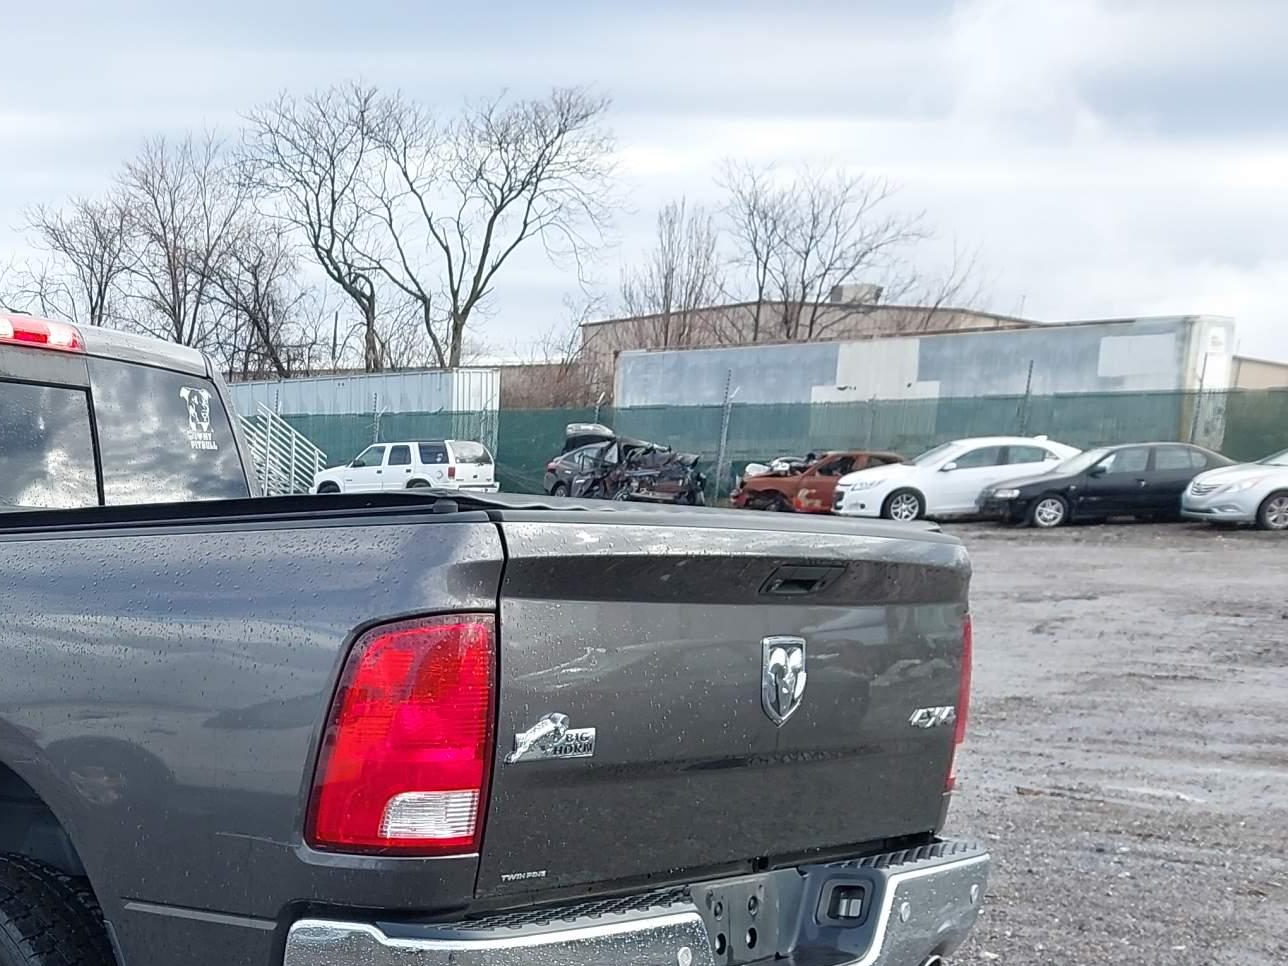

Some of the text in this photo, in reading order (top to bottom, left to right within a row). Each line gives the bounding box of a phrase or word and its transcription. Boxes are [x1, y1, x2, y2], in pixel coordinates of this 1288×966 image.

[190, 441, 218, 450] PITBULL
[565, 732, 590, 743] BIG
[553, 743, 593, 755] HORN
[500, 872, 526, 882] TWIN
